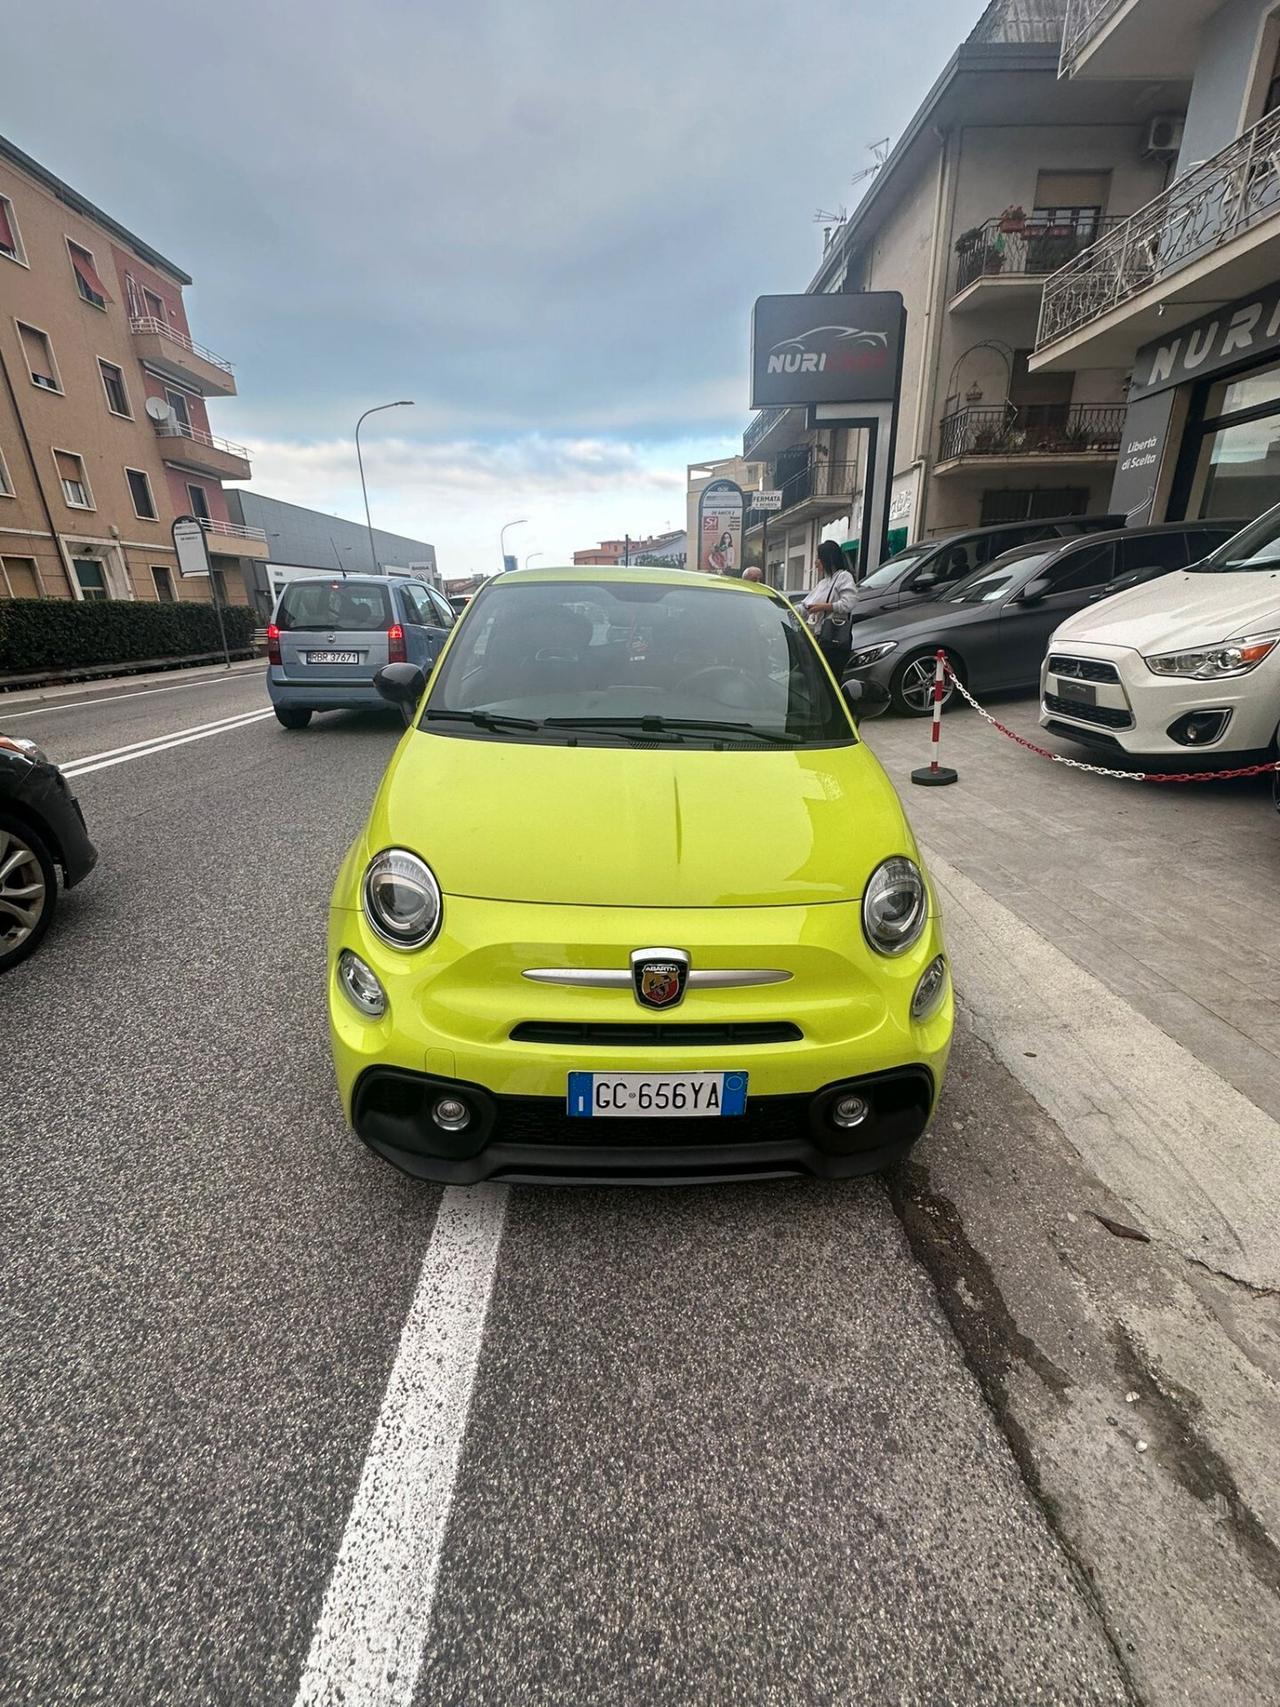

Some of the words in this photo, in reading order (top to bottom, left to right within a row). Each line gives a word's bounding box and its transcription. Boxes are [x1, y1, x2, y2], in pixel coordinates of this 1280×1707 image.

[767, 352, 827, 374] NURI
[1127, 436, 1157, 453] Libertà
[1121, 458, 1131, 470] di
[1130, 454, 1157, 468] Scelta
[330, 652, 356, 662] 37671
